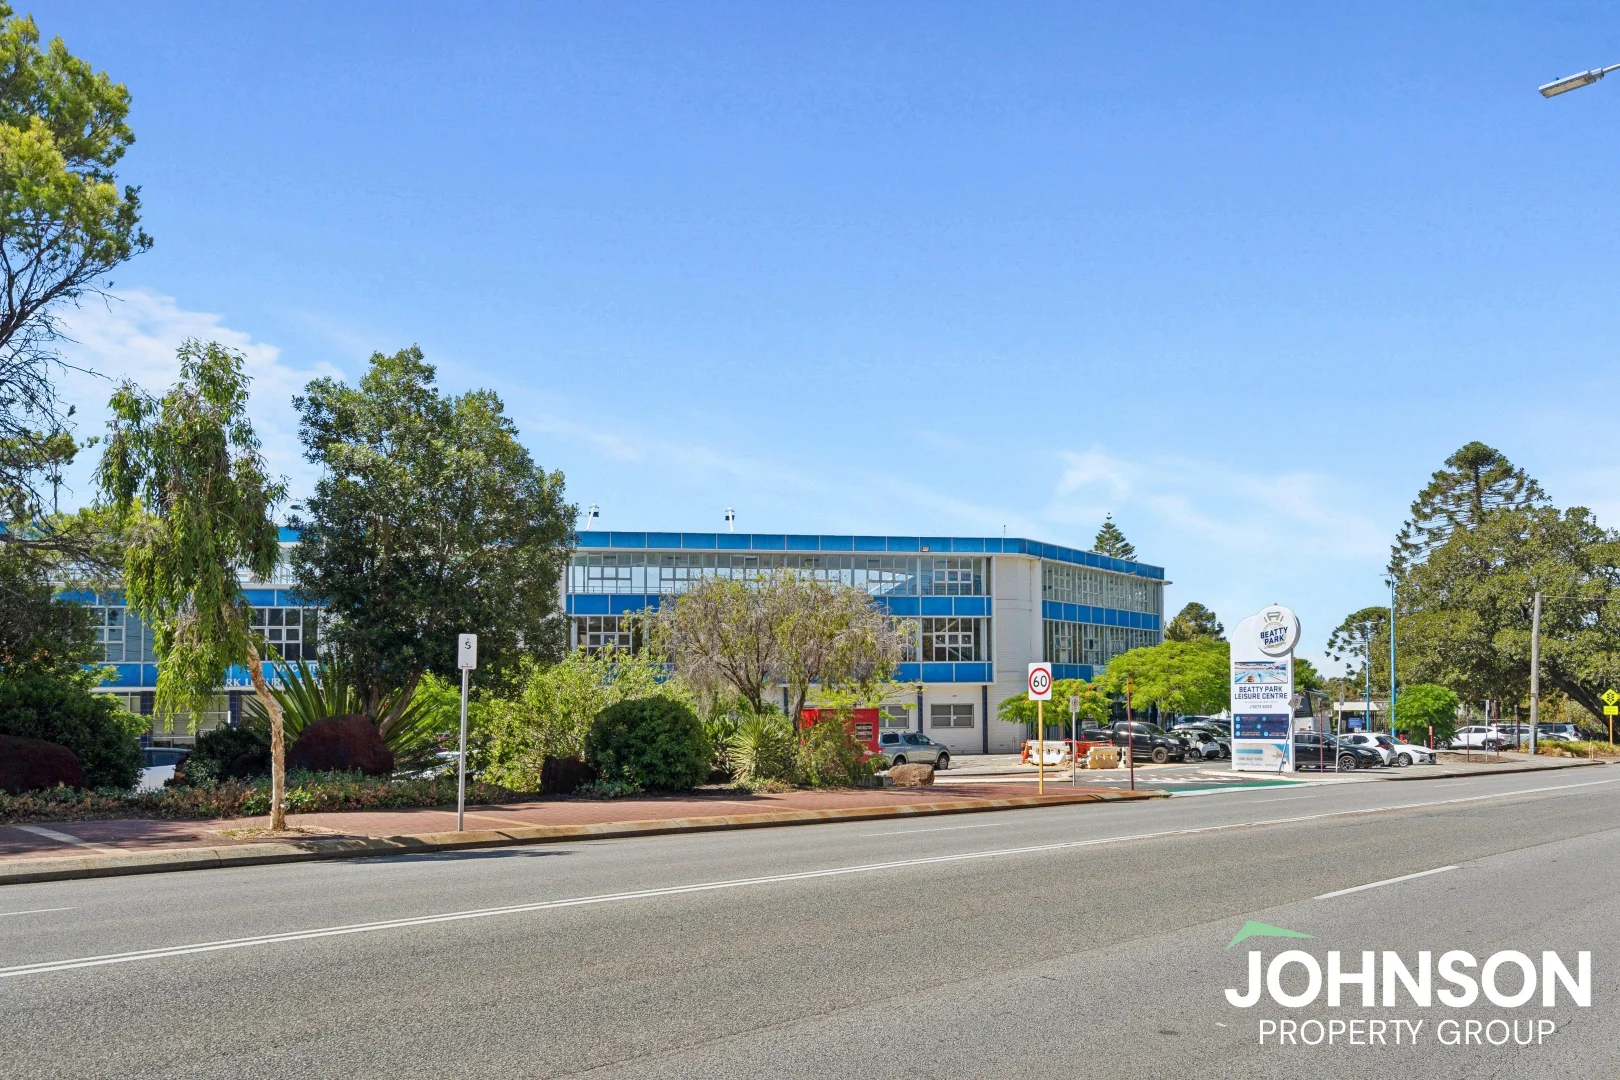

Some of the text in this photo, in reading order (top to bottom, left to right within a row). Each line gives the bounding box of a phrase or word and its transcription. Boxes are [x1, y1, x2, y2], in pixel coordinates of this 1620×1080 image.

[1260, 626, 1288, 639] BEATTY
[1265, 635, 1284, 645] PARK
[1033, 675, 1047, 687] 60
